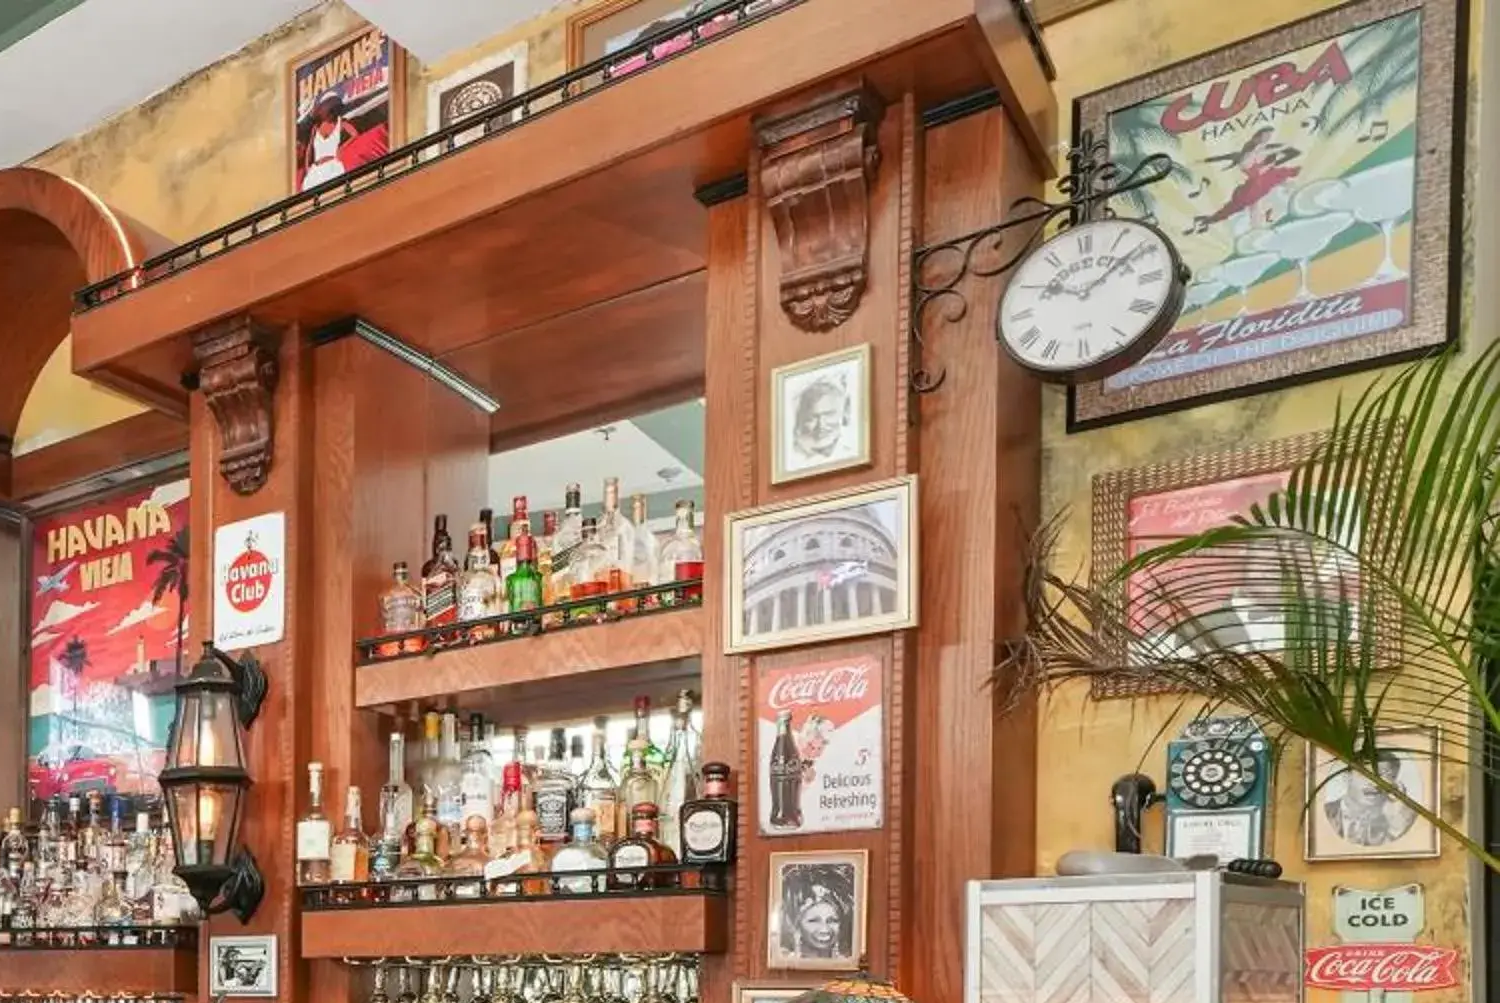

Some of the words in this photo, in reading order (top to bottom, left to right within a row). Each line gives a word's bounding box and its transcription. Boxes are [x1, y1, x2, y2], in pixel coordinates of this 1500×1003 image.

[1160, 41, 1353, 135] CUBA
[1202, 97, 1312, 141] HAVANA
[1197, 296, 1362, 353] Floridita
[47, 503, 171, 563] HAVANA
[79, 551, 134, 592] VIEJA
[221, 555, 280, 586] Havana
[231, 580, 265, 604] Club
[823, 772, 873, 790] Delicious
[819, 792, 877, 810] Refreshing
[1361, 897, 1395, 911] ICE
[1347, 914, 1409, 928] COLD
